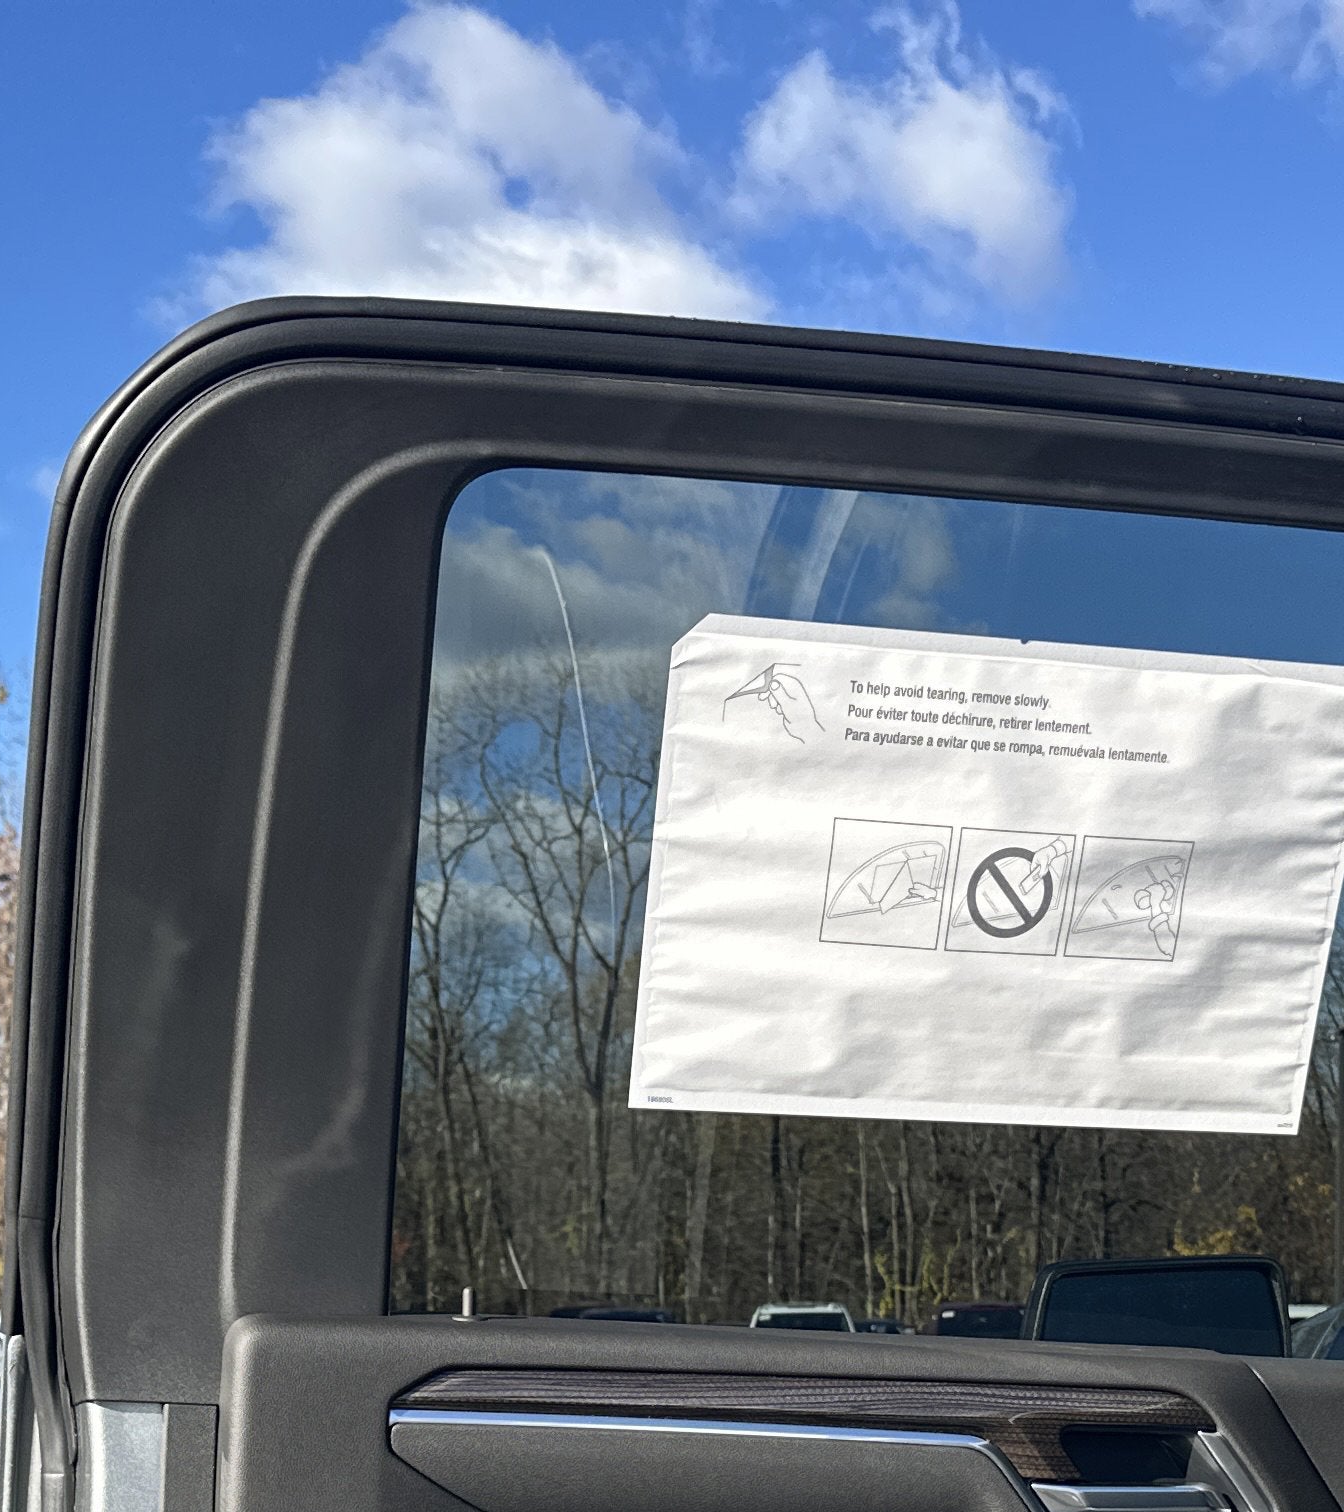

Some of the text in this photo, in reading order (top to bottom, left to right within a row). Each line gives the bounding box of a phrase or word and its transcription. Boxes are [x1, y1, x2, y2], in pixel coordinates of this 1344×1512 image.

[850, 680, 1052, 710] To help avoid tearing, remove slowly.
[848, 704, 1092, 735] Pour éviter toute déchirure, retirer lentement.
[844, 727, 1171, 764] Para ayudarse a evitar que se rompa, remuévala lentamente.
